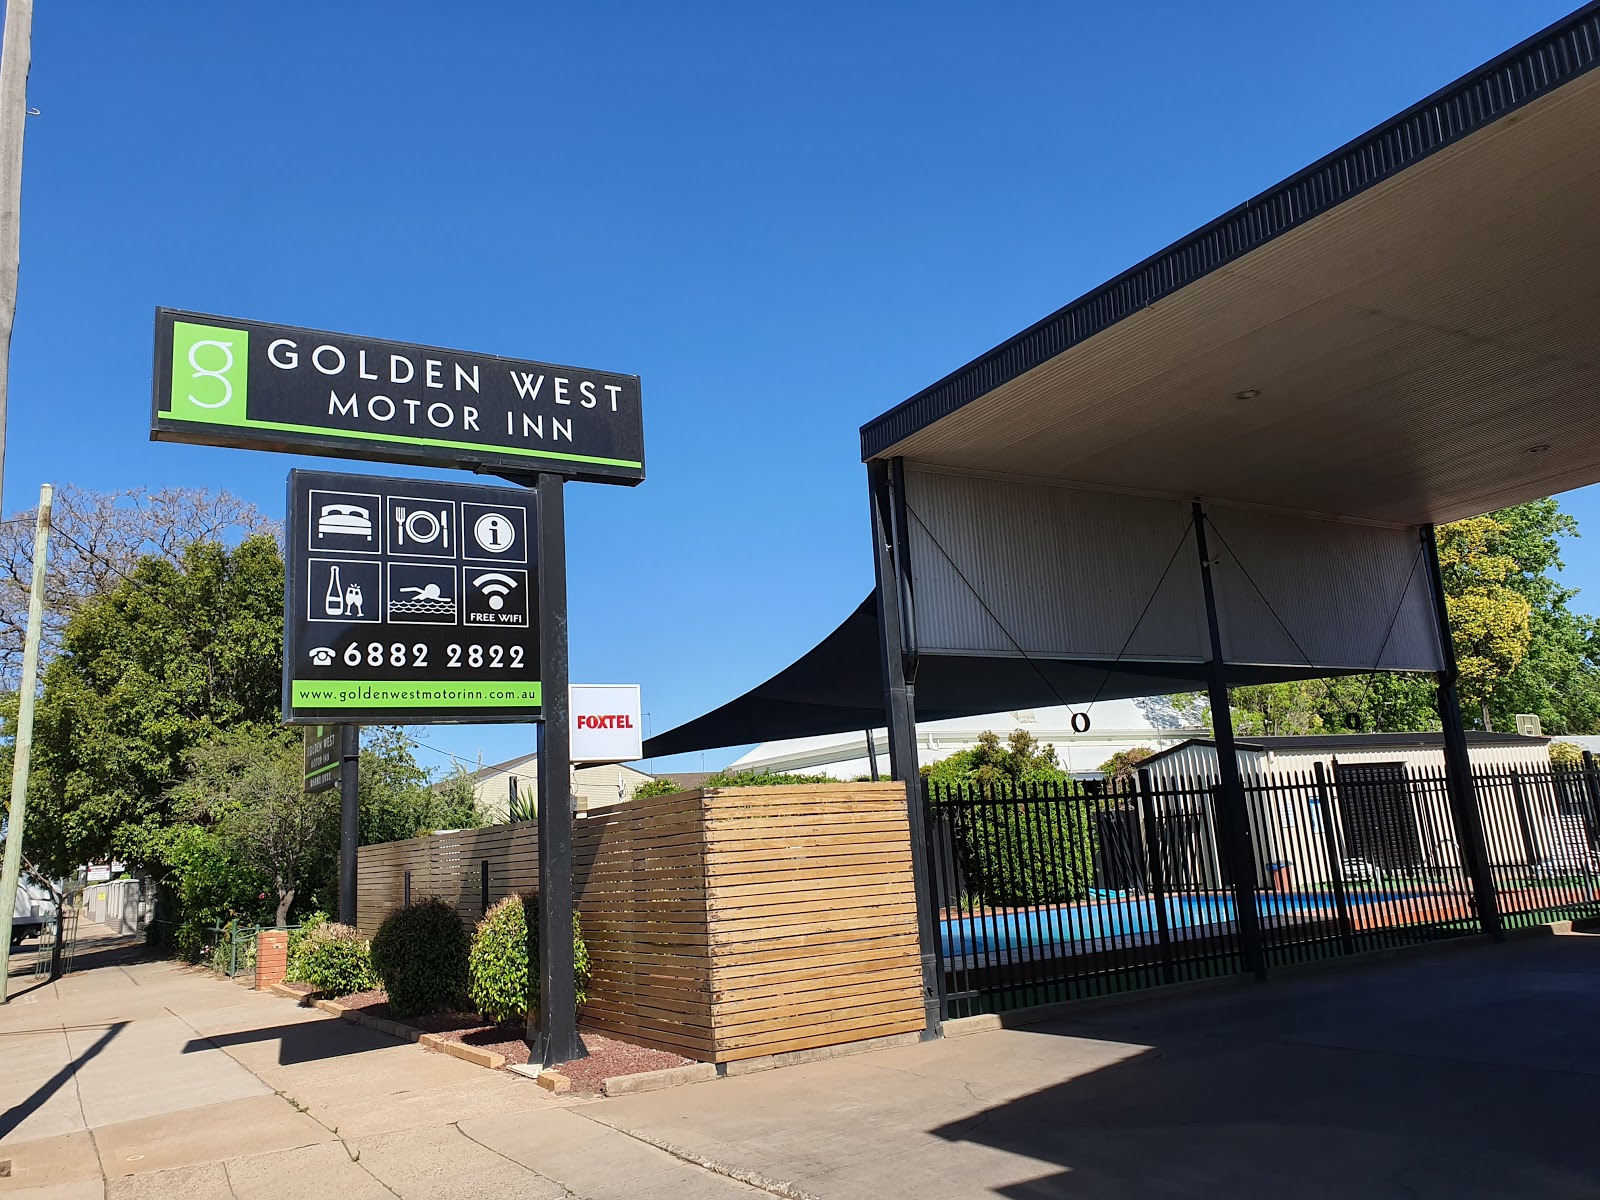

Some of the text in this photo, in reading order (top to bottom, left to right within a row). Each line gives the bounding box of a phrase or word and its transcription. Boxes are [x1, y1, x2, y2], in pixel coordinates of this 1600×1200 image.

[267, 338, 622, 412] GOLDEN WEST
[328, 389, 574, 443] MOTOR INN
[470, 612, 522, 624] FREE WIFI
[343, 641, 525, 668] 6882 2822
[299, 685, 536, 702] www.goldenwestmotorinn.com.au
[577, 714, 633, 730] FOXTEL
